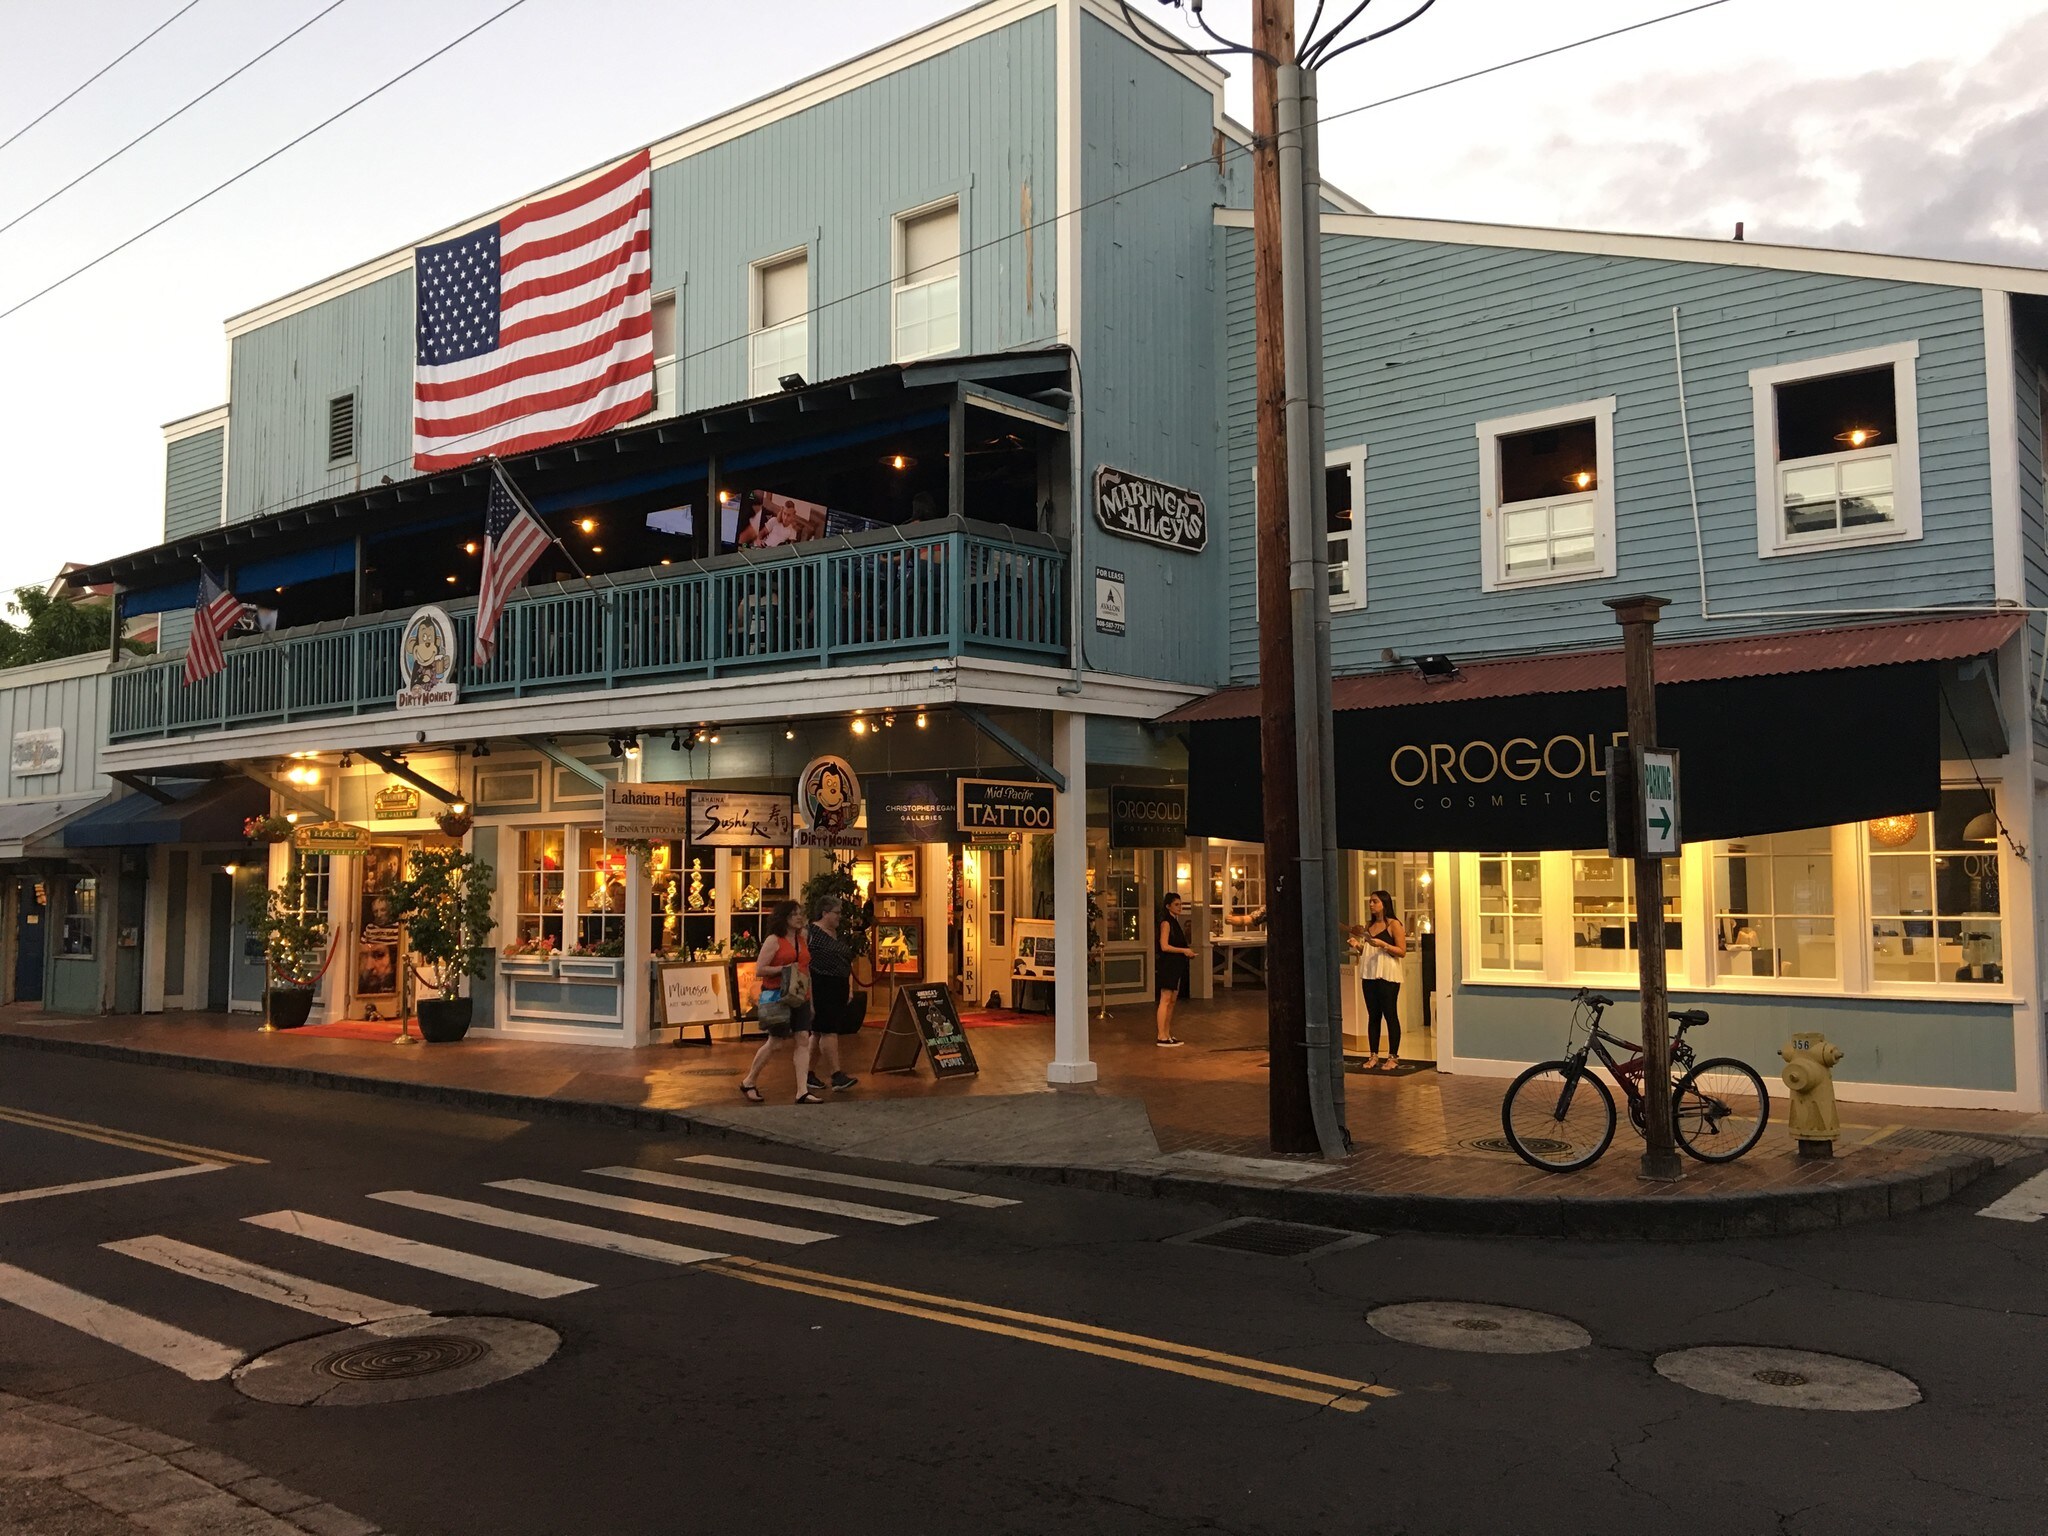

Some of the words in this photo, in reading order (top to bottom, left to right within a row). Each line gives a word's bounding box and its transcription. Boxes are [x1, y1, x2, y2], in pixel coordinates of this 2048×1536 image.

[1096, 568, 1107, 578] FOR
[1108, 571, 1124, 581] LEASE
[1645, 764, 1672, 801] PARKING
[612, 789, 660, 805] Lahaina
[983, 786, 1033, 802] Mid-Pacific
[768, 803, 788, 833] 寿司
[967, 803, 1050, 827] TATTOO
[1117, 800, 1181, 820] OROGOLD
[614, 825, 639, 833] HENNA
[641, 826, 670, 834] TATTOO
[695, 805, 749, 840] Sushi
[313, 830, 355, 838] HARTE
[828, 833, 863, 847] MONKEY
[966, 899, 974, 995] GALLERY
[668, 982, 709, 998] Mimosa
[1793, 1040, 1809, 1050] 356
